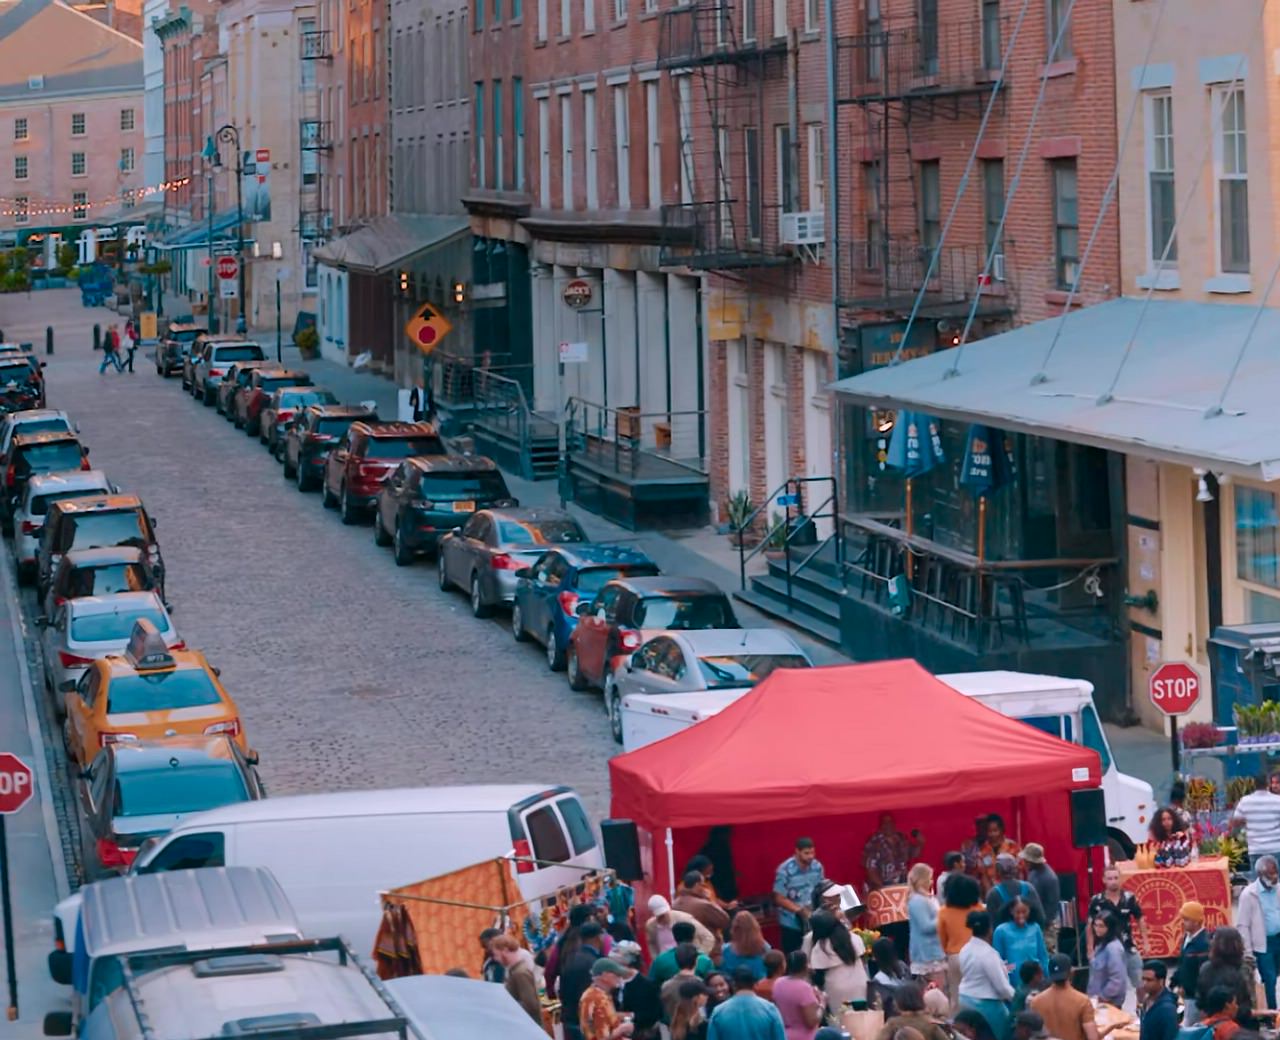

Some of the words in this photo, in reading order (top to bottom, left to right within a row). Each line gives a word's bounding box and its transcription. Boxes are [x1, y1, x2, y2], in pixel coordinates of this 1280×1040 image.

[217, 263, 238, 273] STOP
[1154, 678, 1198, 699] STOP
[0, 771, 28, 794] OP
